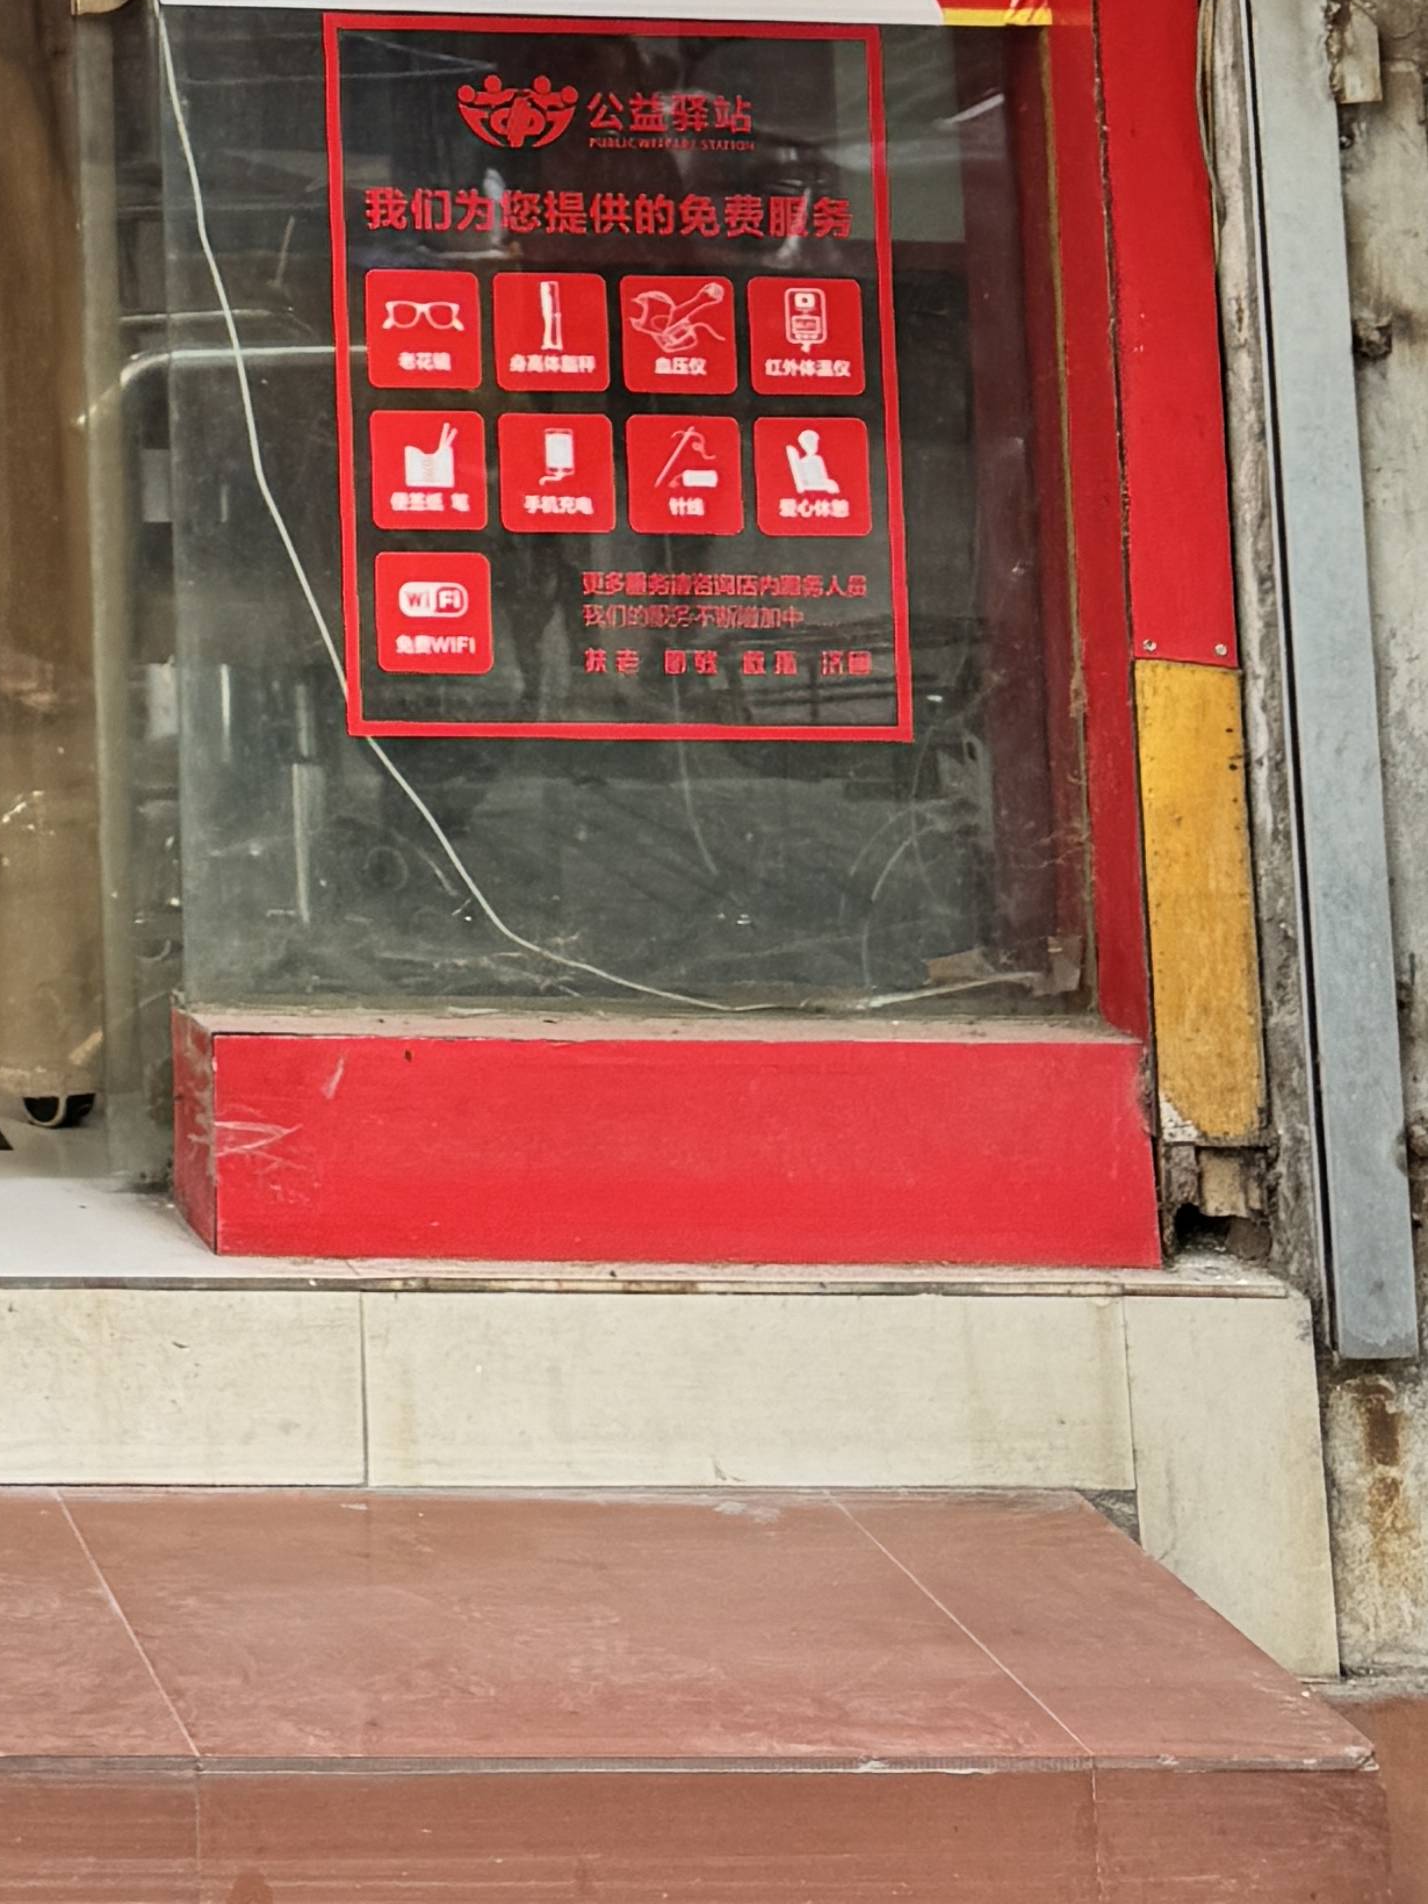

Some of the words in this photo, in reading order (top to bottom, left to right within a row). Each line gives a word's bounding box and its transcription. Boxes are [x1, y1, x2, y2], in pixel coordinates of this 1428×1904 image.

[586, 91, 753, 135] 公益驿站
[364, 186, 854, 240] 我们为您提供的免费服务
[654, 356, 707, 376] 血压仪
[764, 357, 851, 378] 红外体温仪
[523, 494, 594, 515] 手机充电
[668, 496, 705, 517] 针线
[395, 634, 477, 655] 免费WIFI
